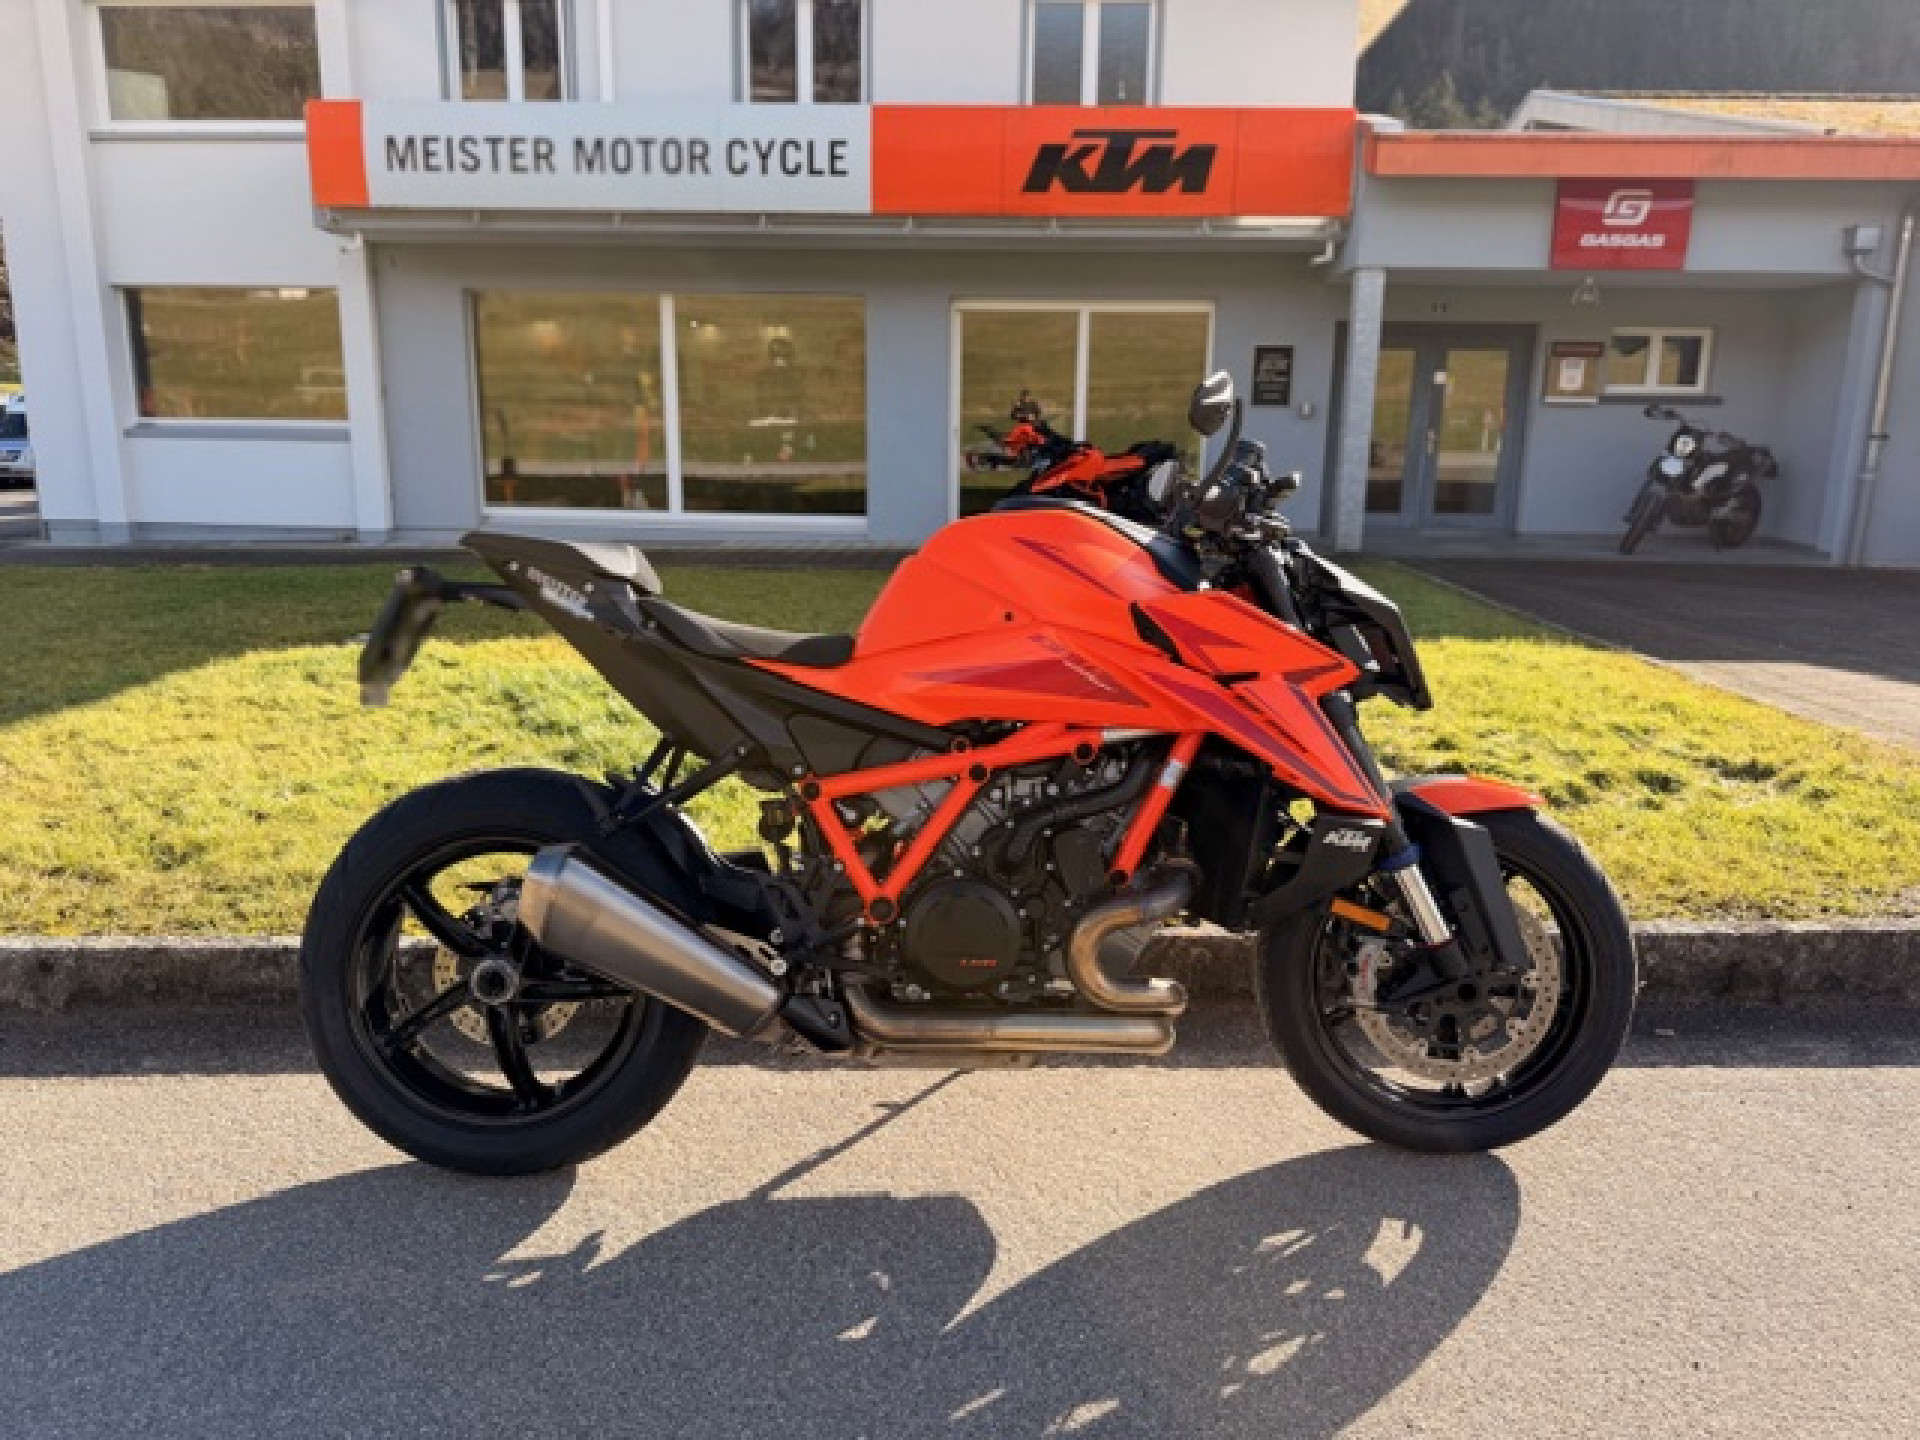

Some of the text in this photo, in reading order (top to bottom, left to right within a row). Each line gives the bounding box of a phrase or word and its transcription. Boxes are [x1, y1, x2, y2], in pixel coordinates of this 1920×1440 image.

[385, 135, 849, 177] MEISTER MOTOR CYCLE
[1021, 128, 1218, 194] KTM
